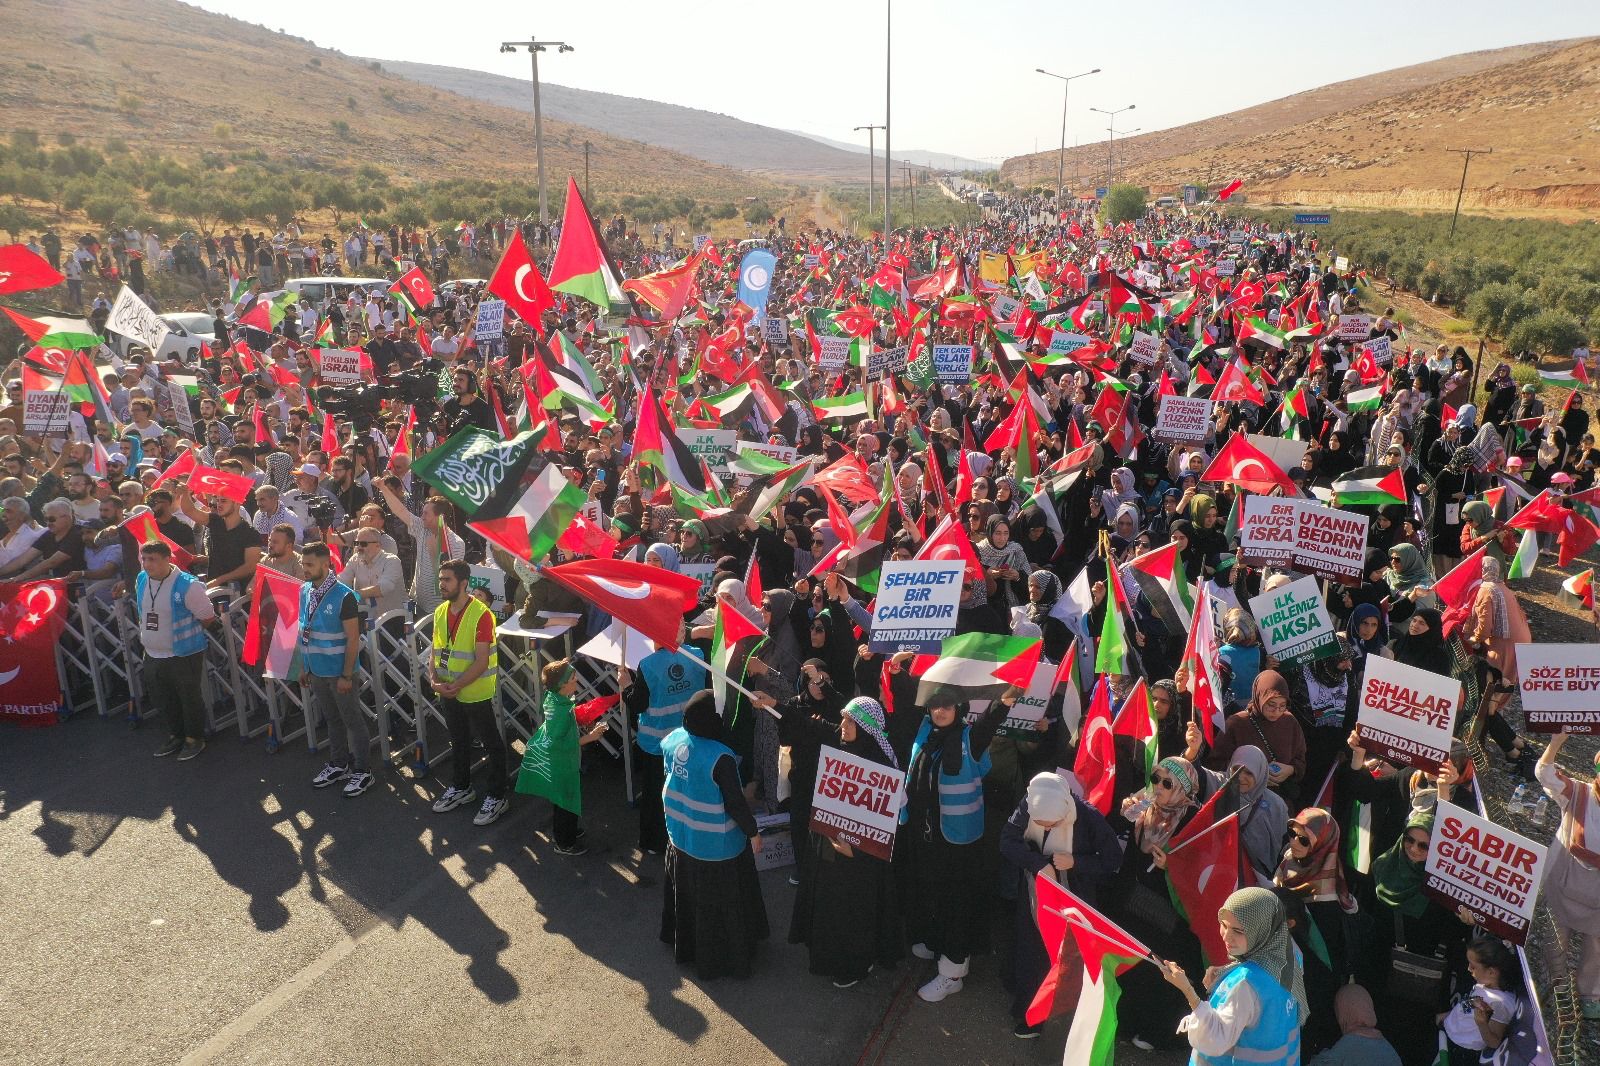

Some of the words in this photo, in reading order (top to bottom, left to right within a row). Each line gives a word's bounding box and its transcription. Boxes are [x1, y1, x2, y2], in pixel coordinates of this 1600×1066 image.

[323, 356, 359, 364] YIKILSIN
[28, 394, 69, 403] UYANIN
[1248, 515, 1296, 528] AVUÇS
[1300, 511, 1365, 537] UYANIN
[1249, 526, 1295, 543] İSRA
[1243, 547, 1294, 560] SINIRDA
[1296, 542, 1363, 563] ARSLANLARI
[1294, 555, 1361, 579] SINIRDAYIZ!
[885, 570, 960, 590] ŞEHADET
[878, 603, 954, 622] ÇAĞRIDIR
[873, 630, 952, 641] SINIRDAYIZ!
[1272, 612, 1322, 646] AKSA
[1530, 665, 1561, 679] SÖZ
[1522, 678, 1564, 691] ÖFKE
[1365, 694, 1451, 731] GAZZE'YE
[1360, 727, 1445, 763] SINIRDAYIZ!
[825, 757, 900, 794] YIKILSIN
[818, 774, 895, 819] İSRAİL
[813, 810, 891, 845] SINIRDAYIZ!
[1440, 817, 1538, 876] SABIR
[1436, 841, 1533, 895] GÜLLERİ
[1427, 876, 1526, 930] SINIRDAYIZ!
